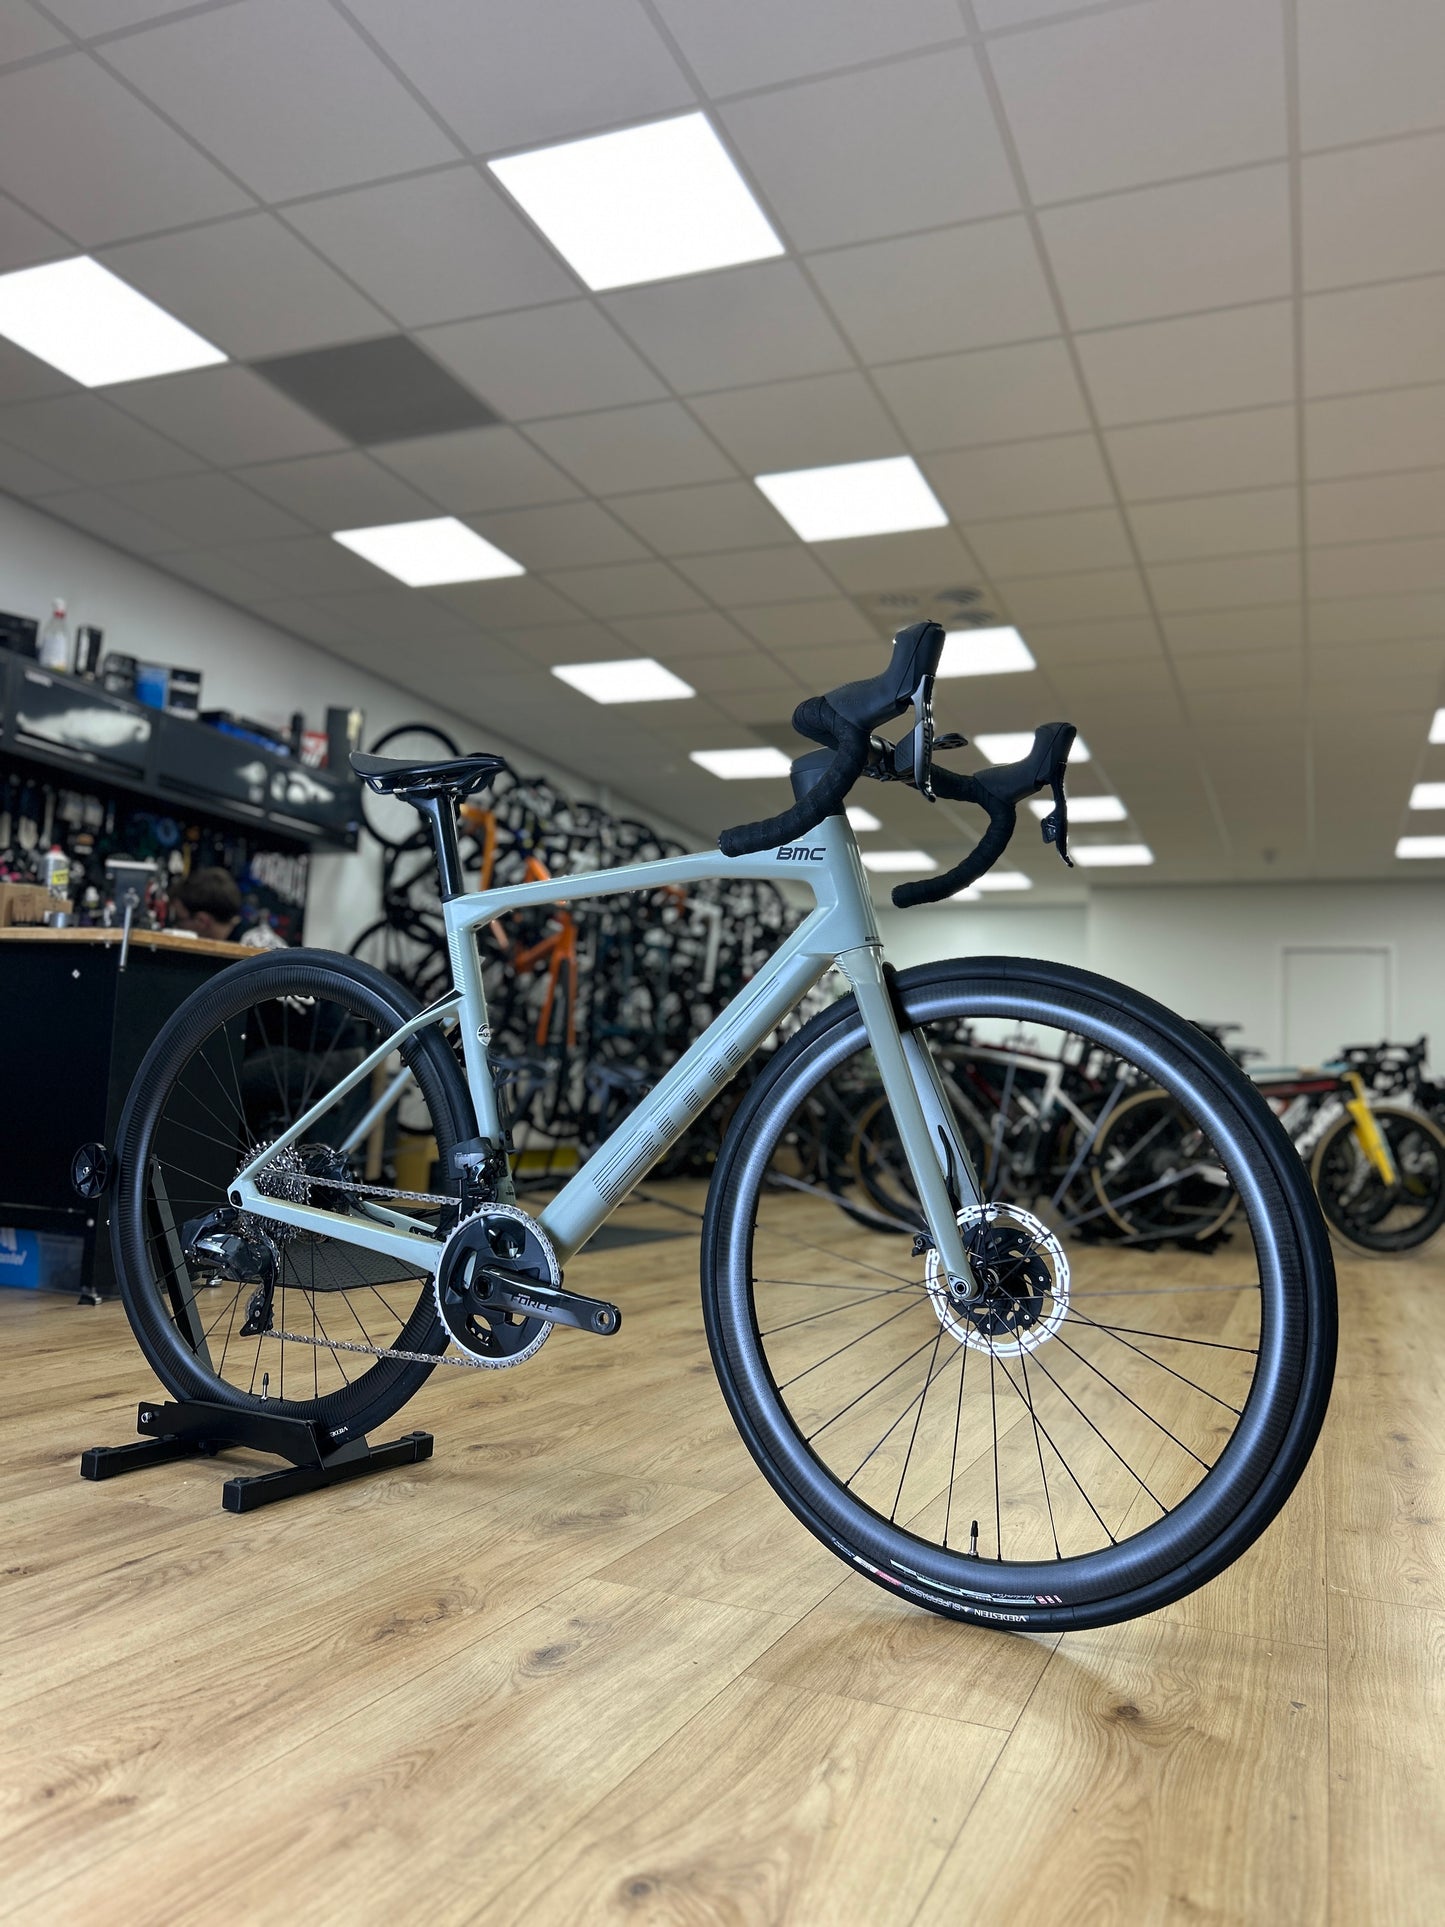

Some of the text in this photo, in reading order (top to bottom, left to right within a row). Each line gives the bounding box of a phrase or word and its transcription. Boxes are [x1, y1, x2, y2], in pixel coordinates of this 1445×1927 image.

[776, 846, 826, 860] BMC
[511, 1294, 552, 1313] FORCE
[974, 1608, 1028, 1622] VREDESTEIN
